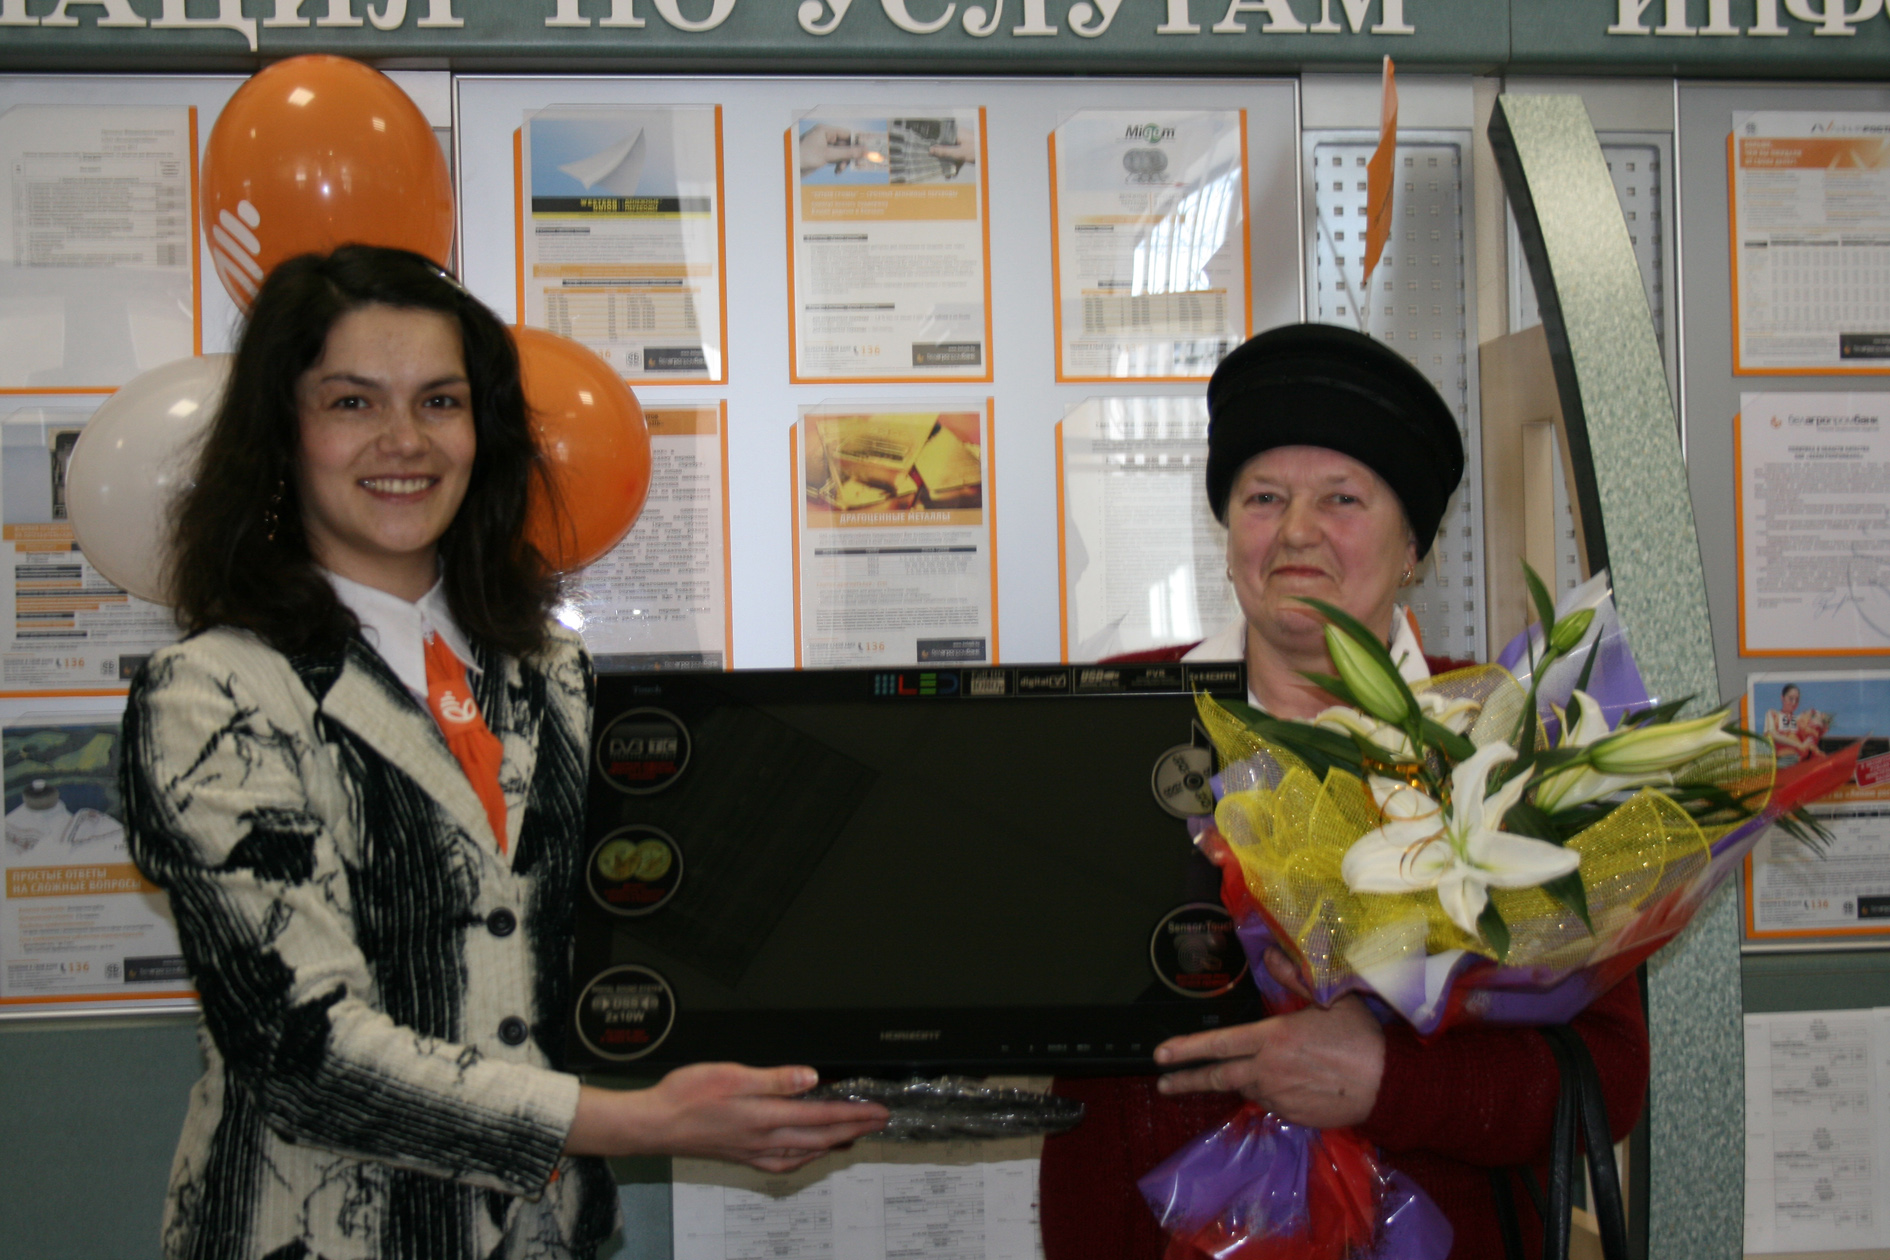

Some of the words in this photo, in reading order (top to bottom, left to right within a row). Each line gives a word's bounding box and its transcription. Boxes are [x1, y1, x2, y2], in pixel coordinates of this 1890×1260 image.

[861, 344, 881, 356] 136
[866, 641, 885, 651] 136
[64, 657, 85, 668] 136
[12, 868, 63, 881] ПРОСТЫЕ
[65, 866, 107, 879] ОТВЕТЫ
[12, 882, 28, 894] НА
[30, 878, 86, 892] СЛОЖНЫЕ
[89, 875, 142, 890] ВОПРОСЫ
[69, 962, 90, 973] 136
